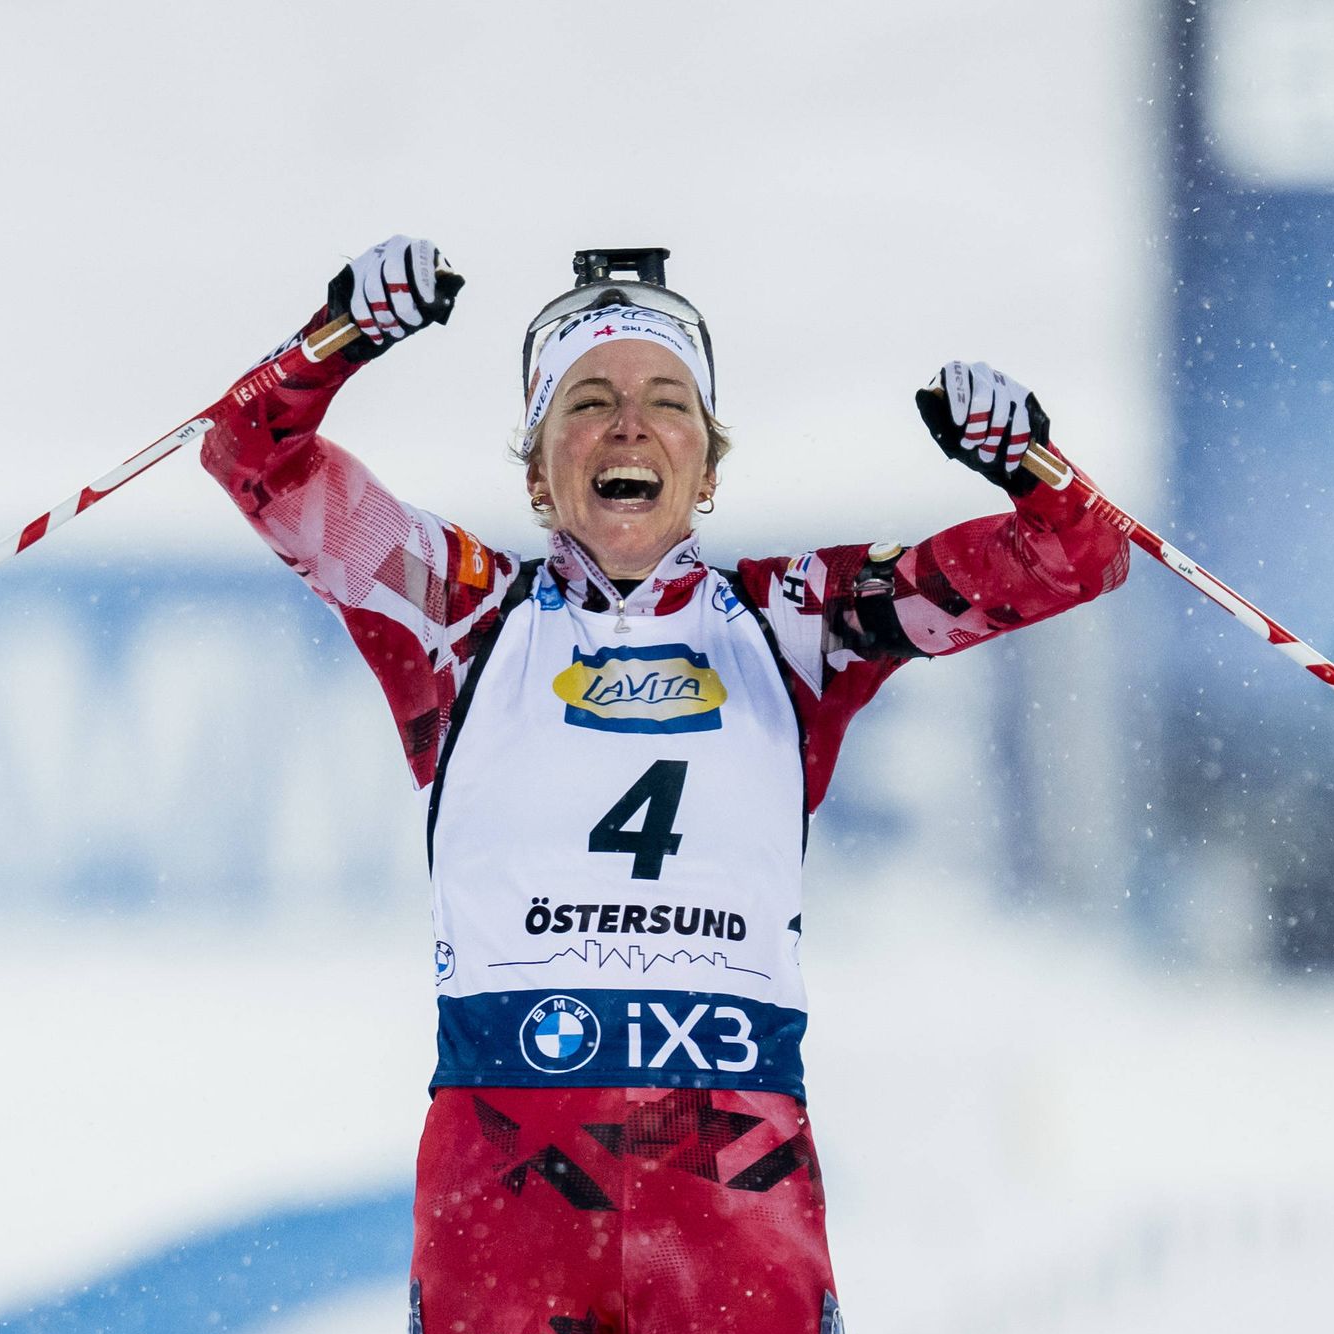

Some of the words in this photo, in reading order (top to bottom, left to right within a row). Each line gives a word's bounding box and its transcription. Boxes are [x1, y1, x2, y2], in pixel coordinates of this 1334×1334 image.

[621, 324, 641, 332] Ski
[644, 327, 683, 351] Austria
[587, 758, 690, 881] 4
[524, 897, 748, 942] ÖSTERSUND
[531, 999, 590, 1023] BMW
[626, 1001, 759, 1073] iX3
